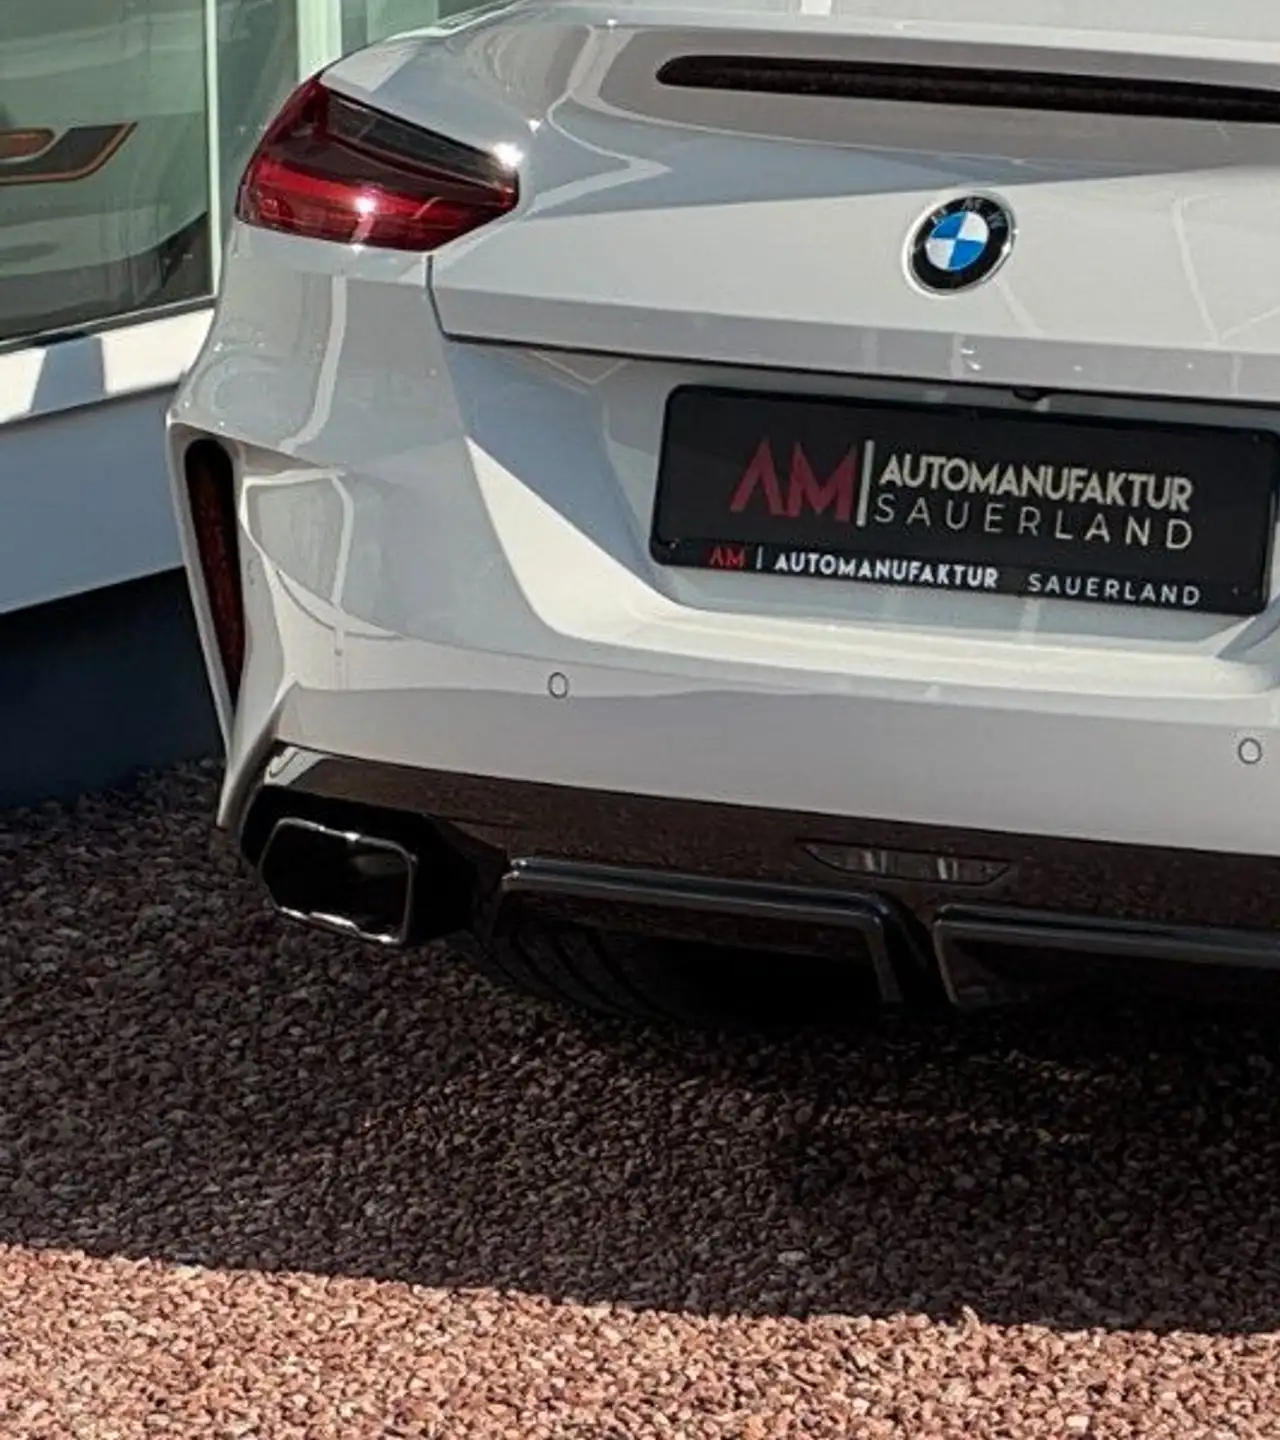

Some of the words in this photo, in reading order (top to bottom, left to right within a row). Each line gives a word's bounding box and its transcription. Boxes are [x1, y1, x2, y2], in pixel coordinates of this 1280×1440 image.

[729, 438, 858, 522] AM
[878, 452, 1193, 513] AUTOMANUFAKTUR
[874, 492, 1193, 550] SAUERLAND
[773, 550, 998, 589] AUTOMANUFAKTUR
[1027, 572, 1201, 606] SAUERLAND
